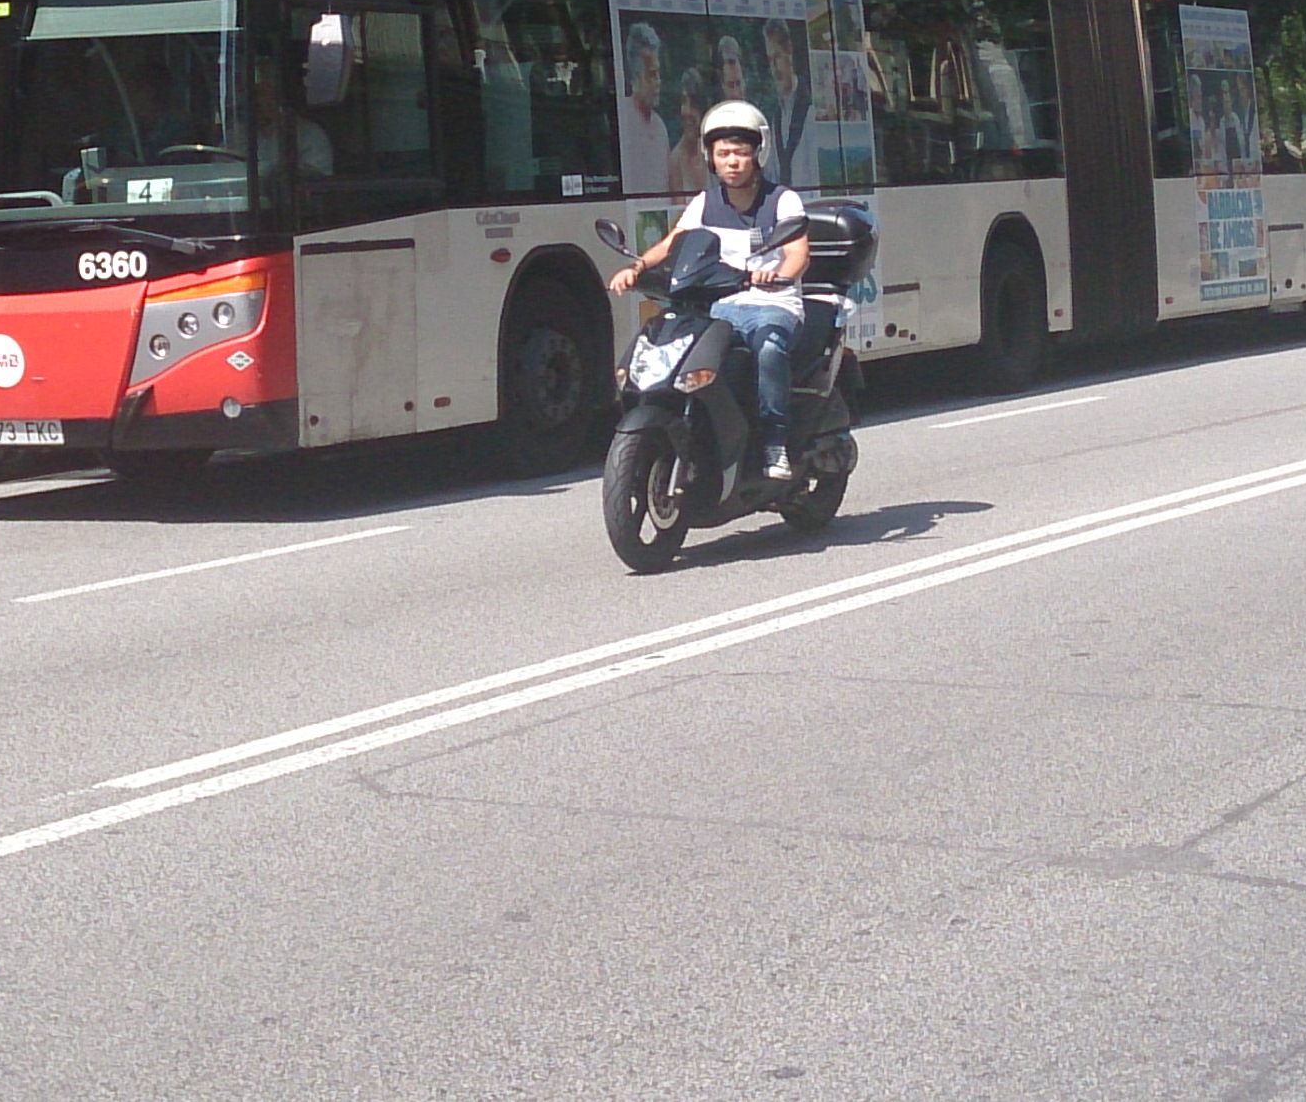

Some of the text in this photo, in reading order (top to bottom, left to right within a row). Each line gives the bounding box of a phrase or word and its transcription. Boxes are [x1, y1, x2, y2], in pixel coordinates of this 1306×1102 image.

[138, 181, 153, 203] 4
[78, 250, 148, 280] 6360
[25, 421, 60, 442] FKC
